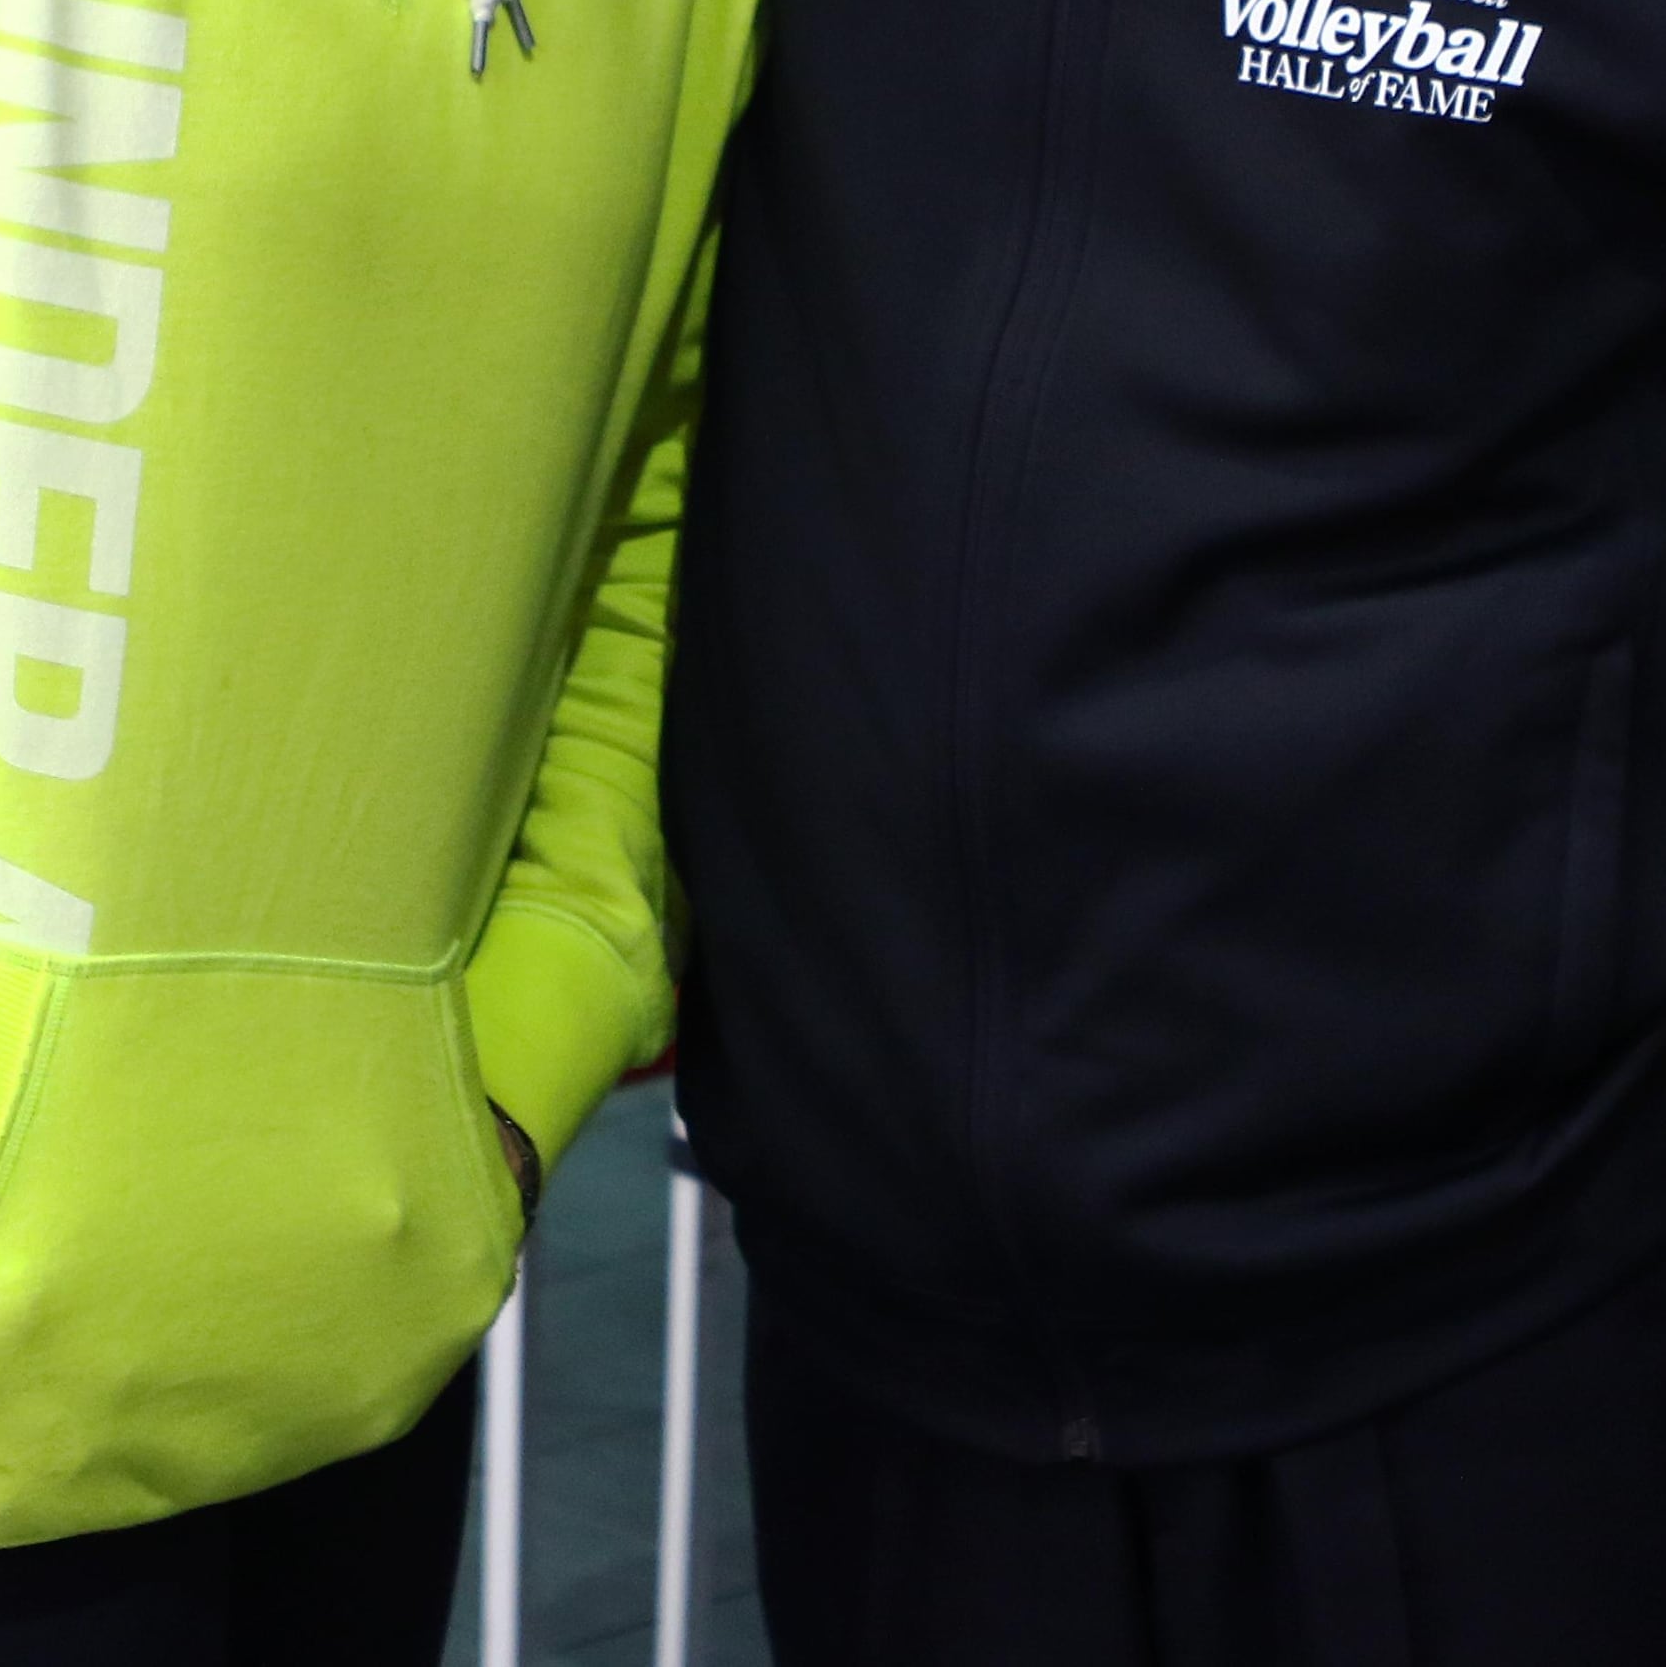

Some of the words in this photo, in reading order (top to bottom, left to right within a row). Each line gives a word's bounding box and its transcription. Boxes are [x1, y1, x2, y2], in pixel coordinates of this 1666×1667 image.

[1238, 45, 1346, 99] HALL
[1349, 72, 1375, 102] of
[1374, 74, 1495, 123] FAME
